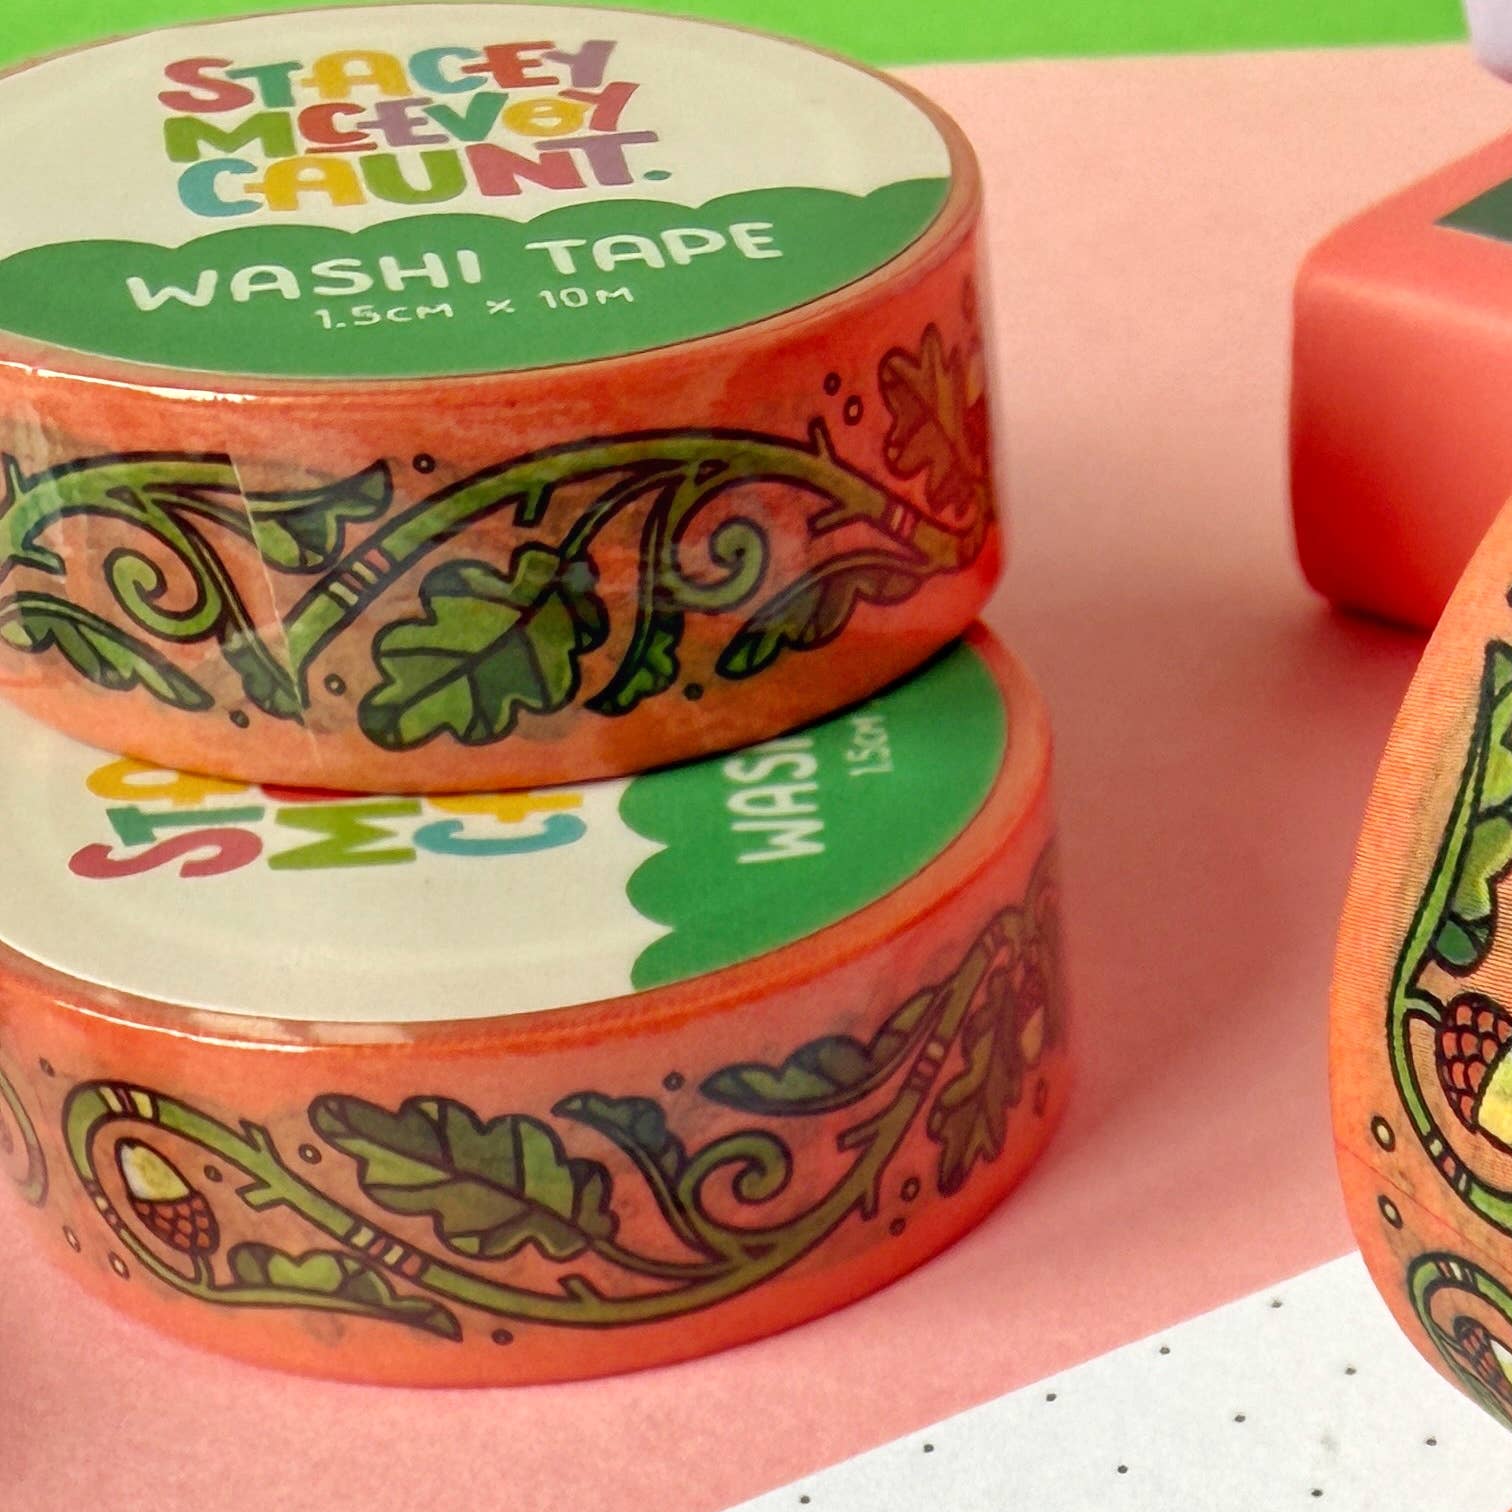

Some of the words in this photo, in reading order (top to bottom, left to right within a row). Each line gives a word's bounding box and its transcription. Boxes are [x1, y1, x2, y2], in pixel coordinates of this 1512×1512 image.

[158, 39, 618, 113] STACEY
[126, 248, 481, 312] WASHI
[525, 221, 783, 275] TAPE
